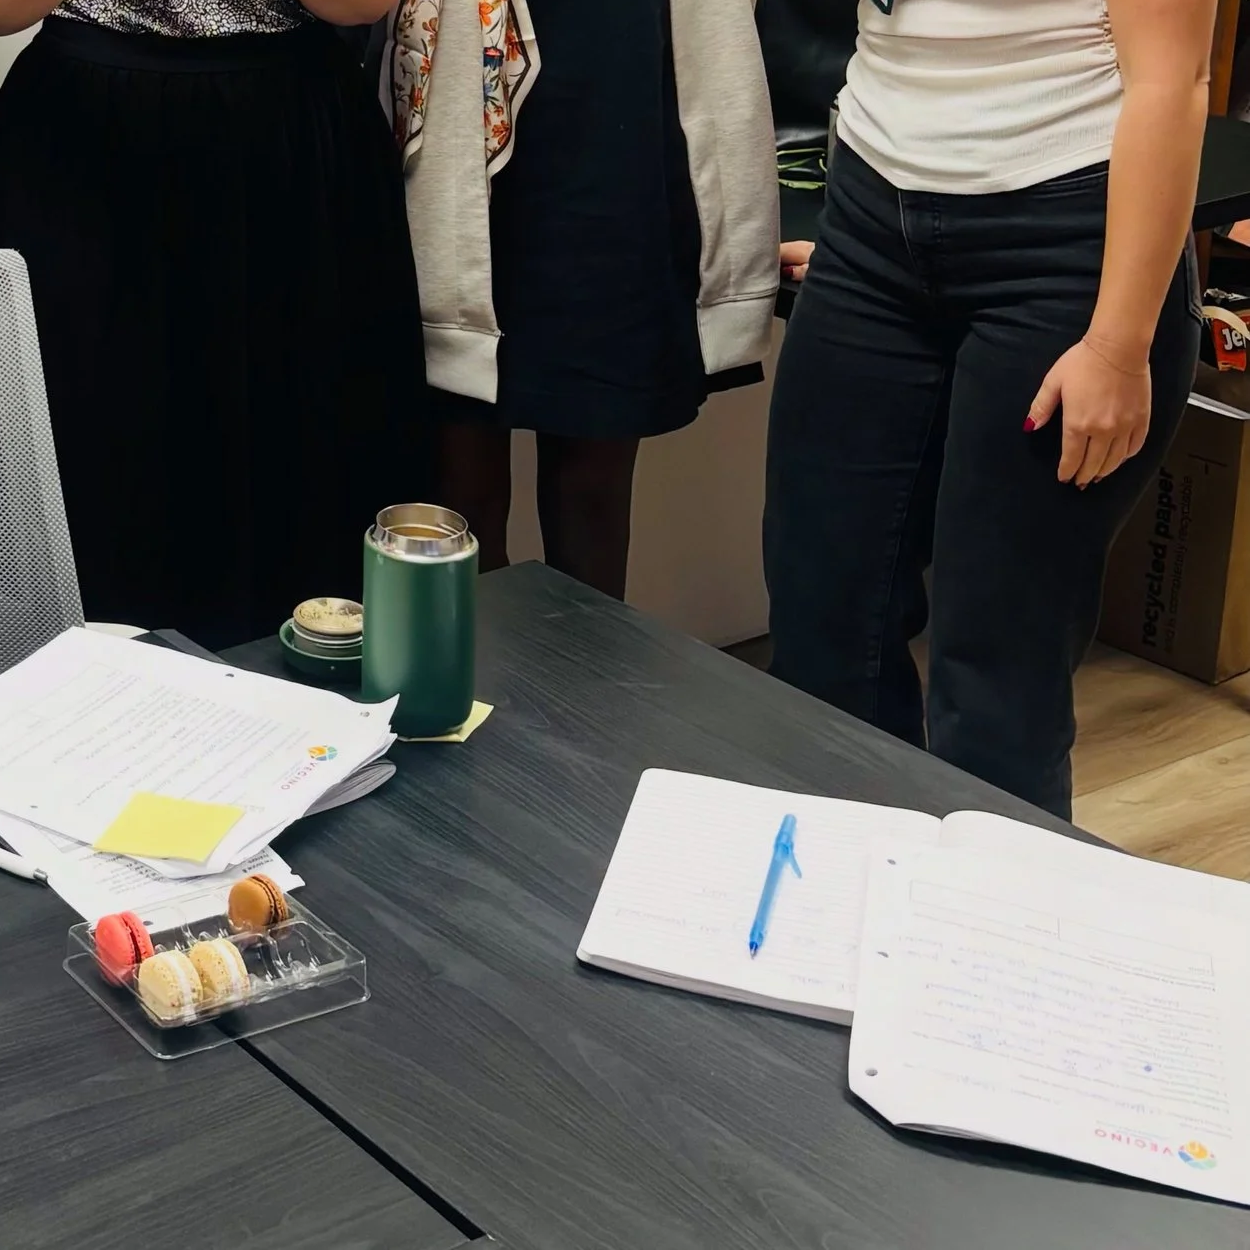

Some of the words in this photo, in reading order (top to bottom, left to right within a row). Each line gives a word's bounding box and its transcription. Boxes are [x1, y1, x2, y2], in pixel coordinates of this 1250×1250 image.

[1152, 465, 1175, 539] paper
[1176, 474, 1194, 542] recyclable
[1141, 538, 1168, 648] recycled
[280, 761, 317, 790] VECINO
[1094, 1128, 1173, 1156] VECINO
